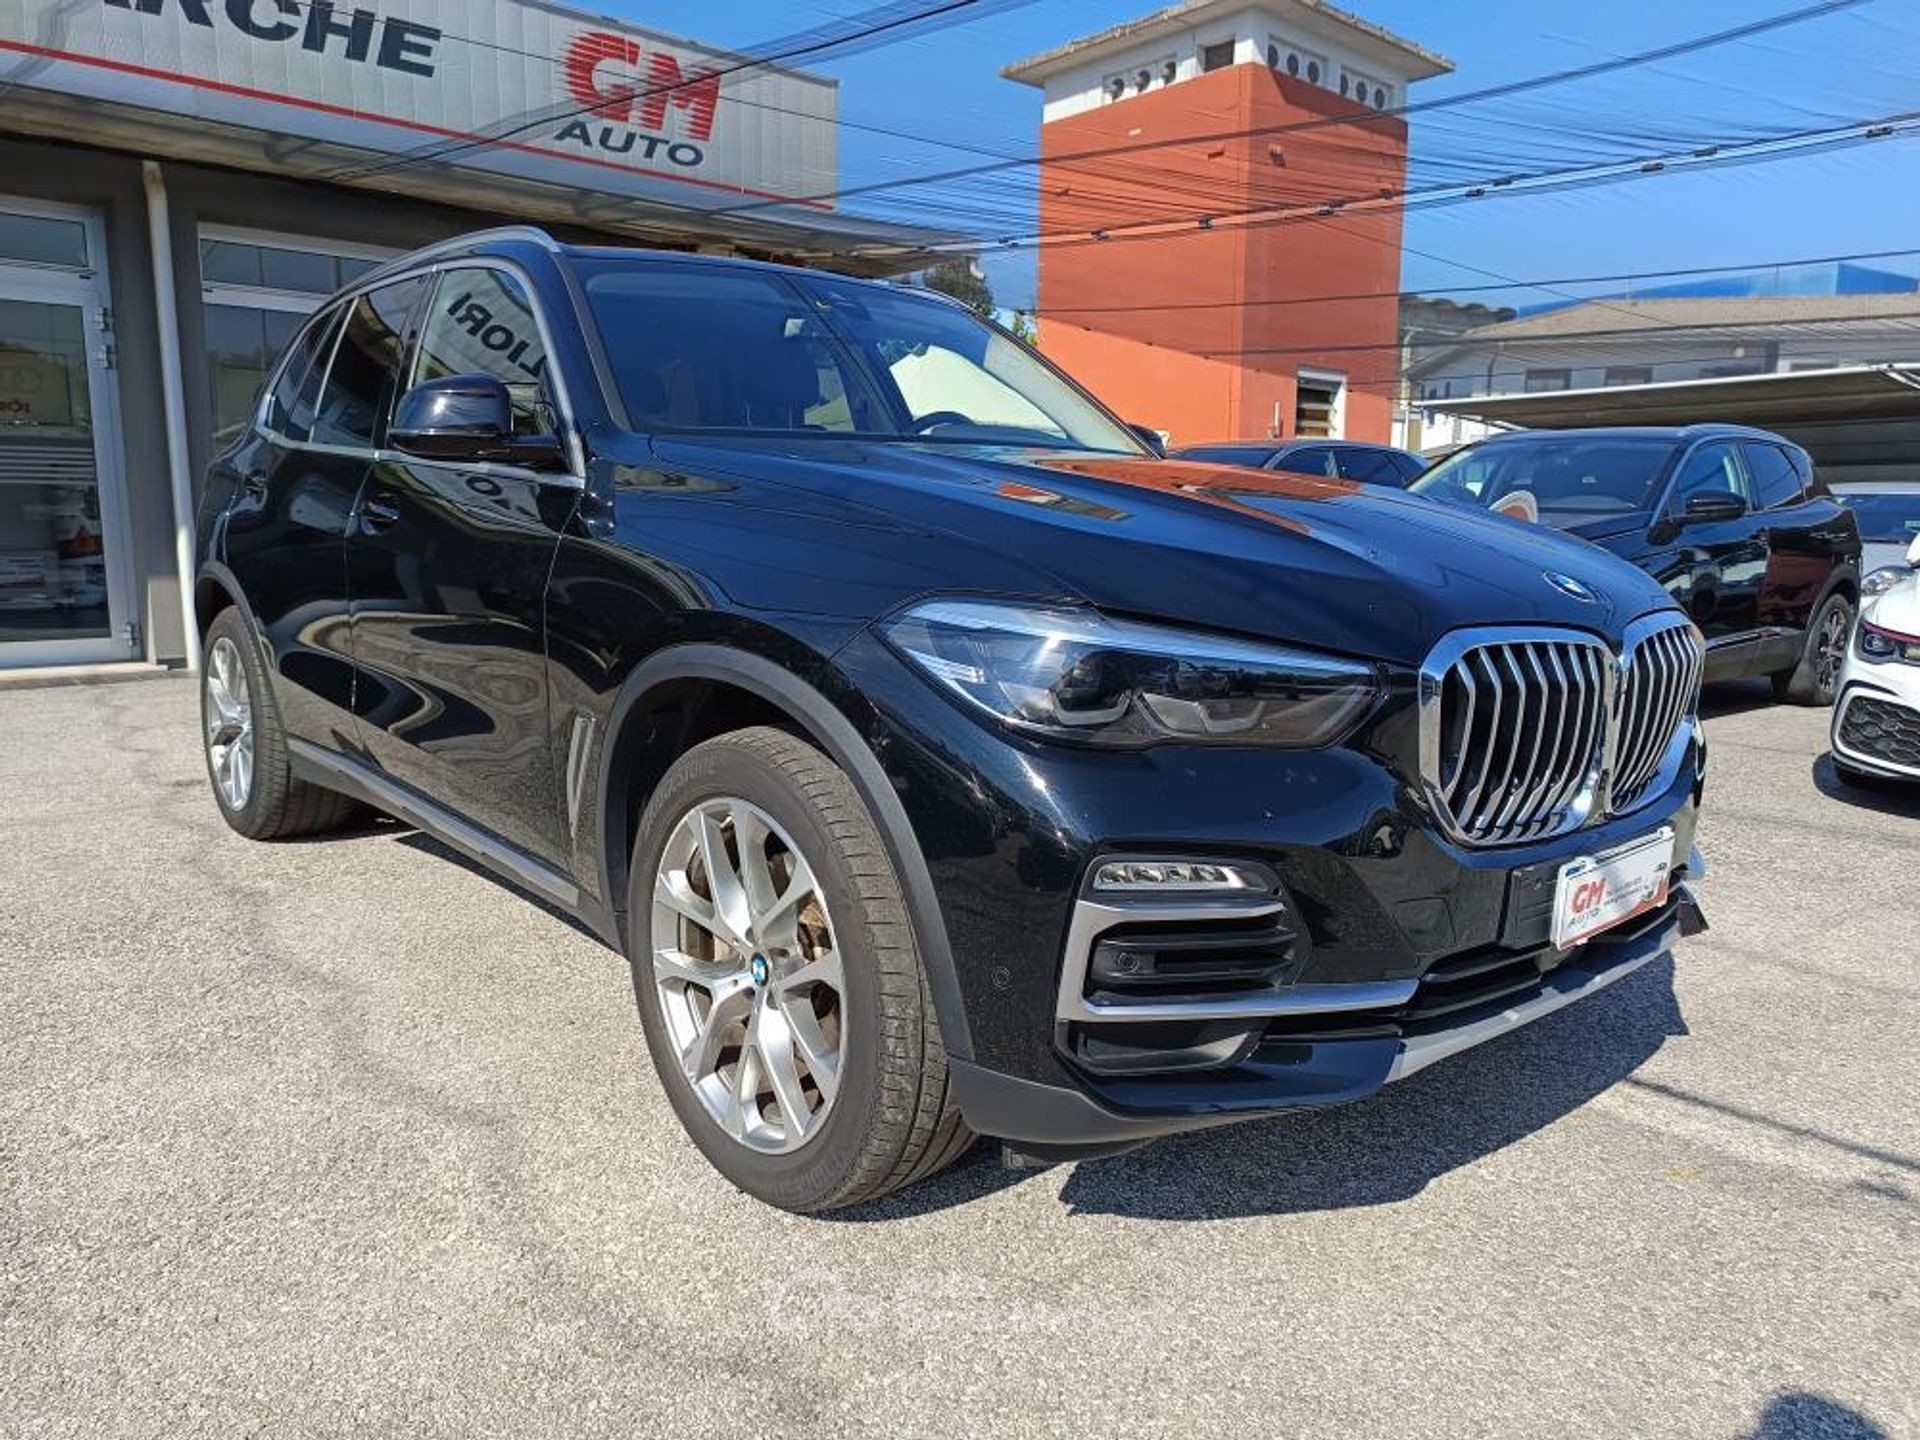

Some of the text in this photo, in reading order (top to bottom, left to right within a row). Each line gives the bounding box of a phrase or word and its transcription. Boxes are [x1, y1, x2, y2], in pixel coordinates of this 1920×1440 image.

[104, 0, 441, 78] CHE
[564, 31, 721, 142] GM
[553, 120, 704, 167] AUTO
[1572, 877, 1606, 914] GM
